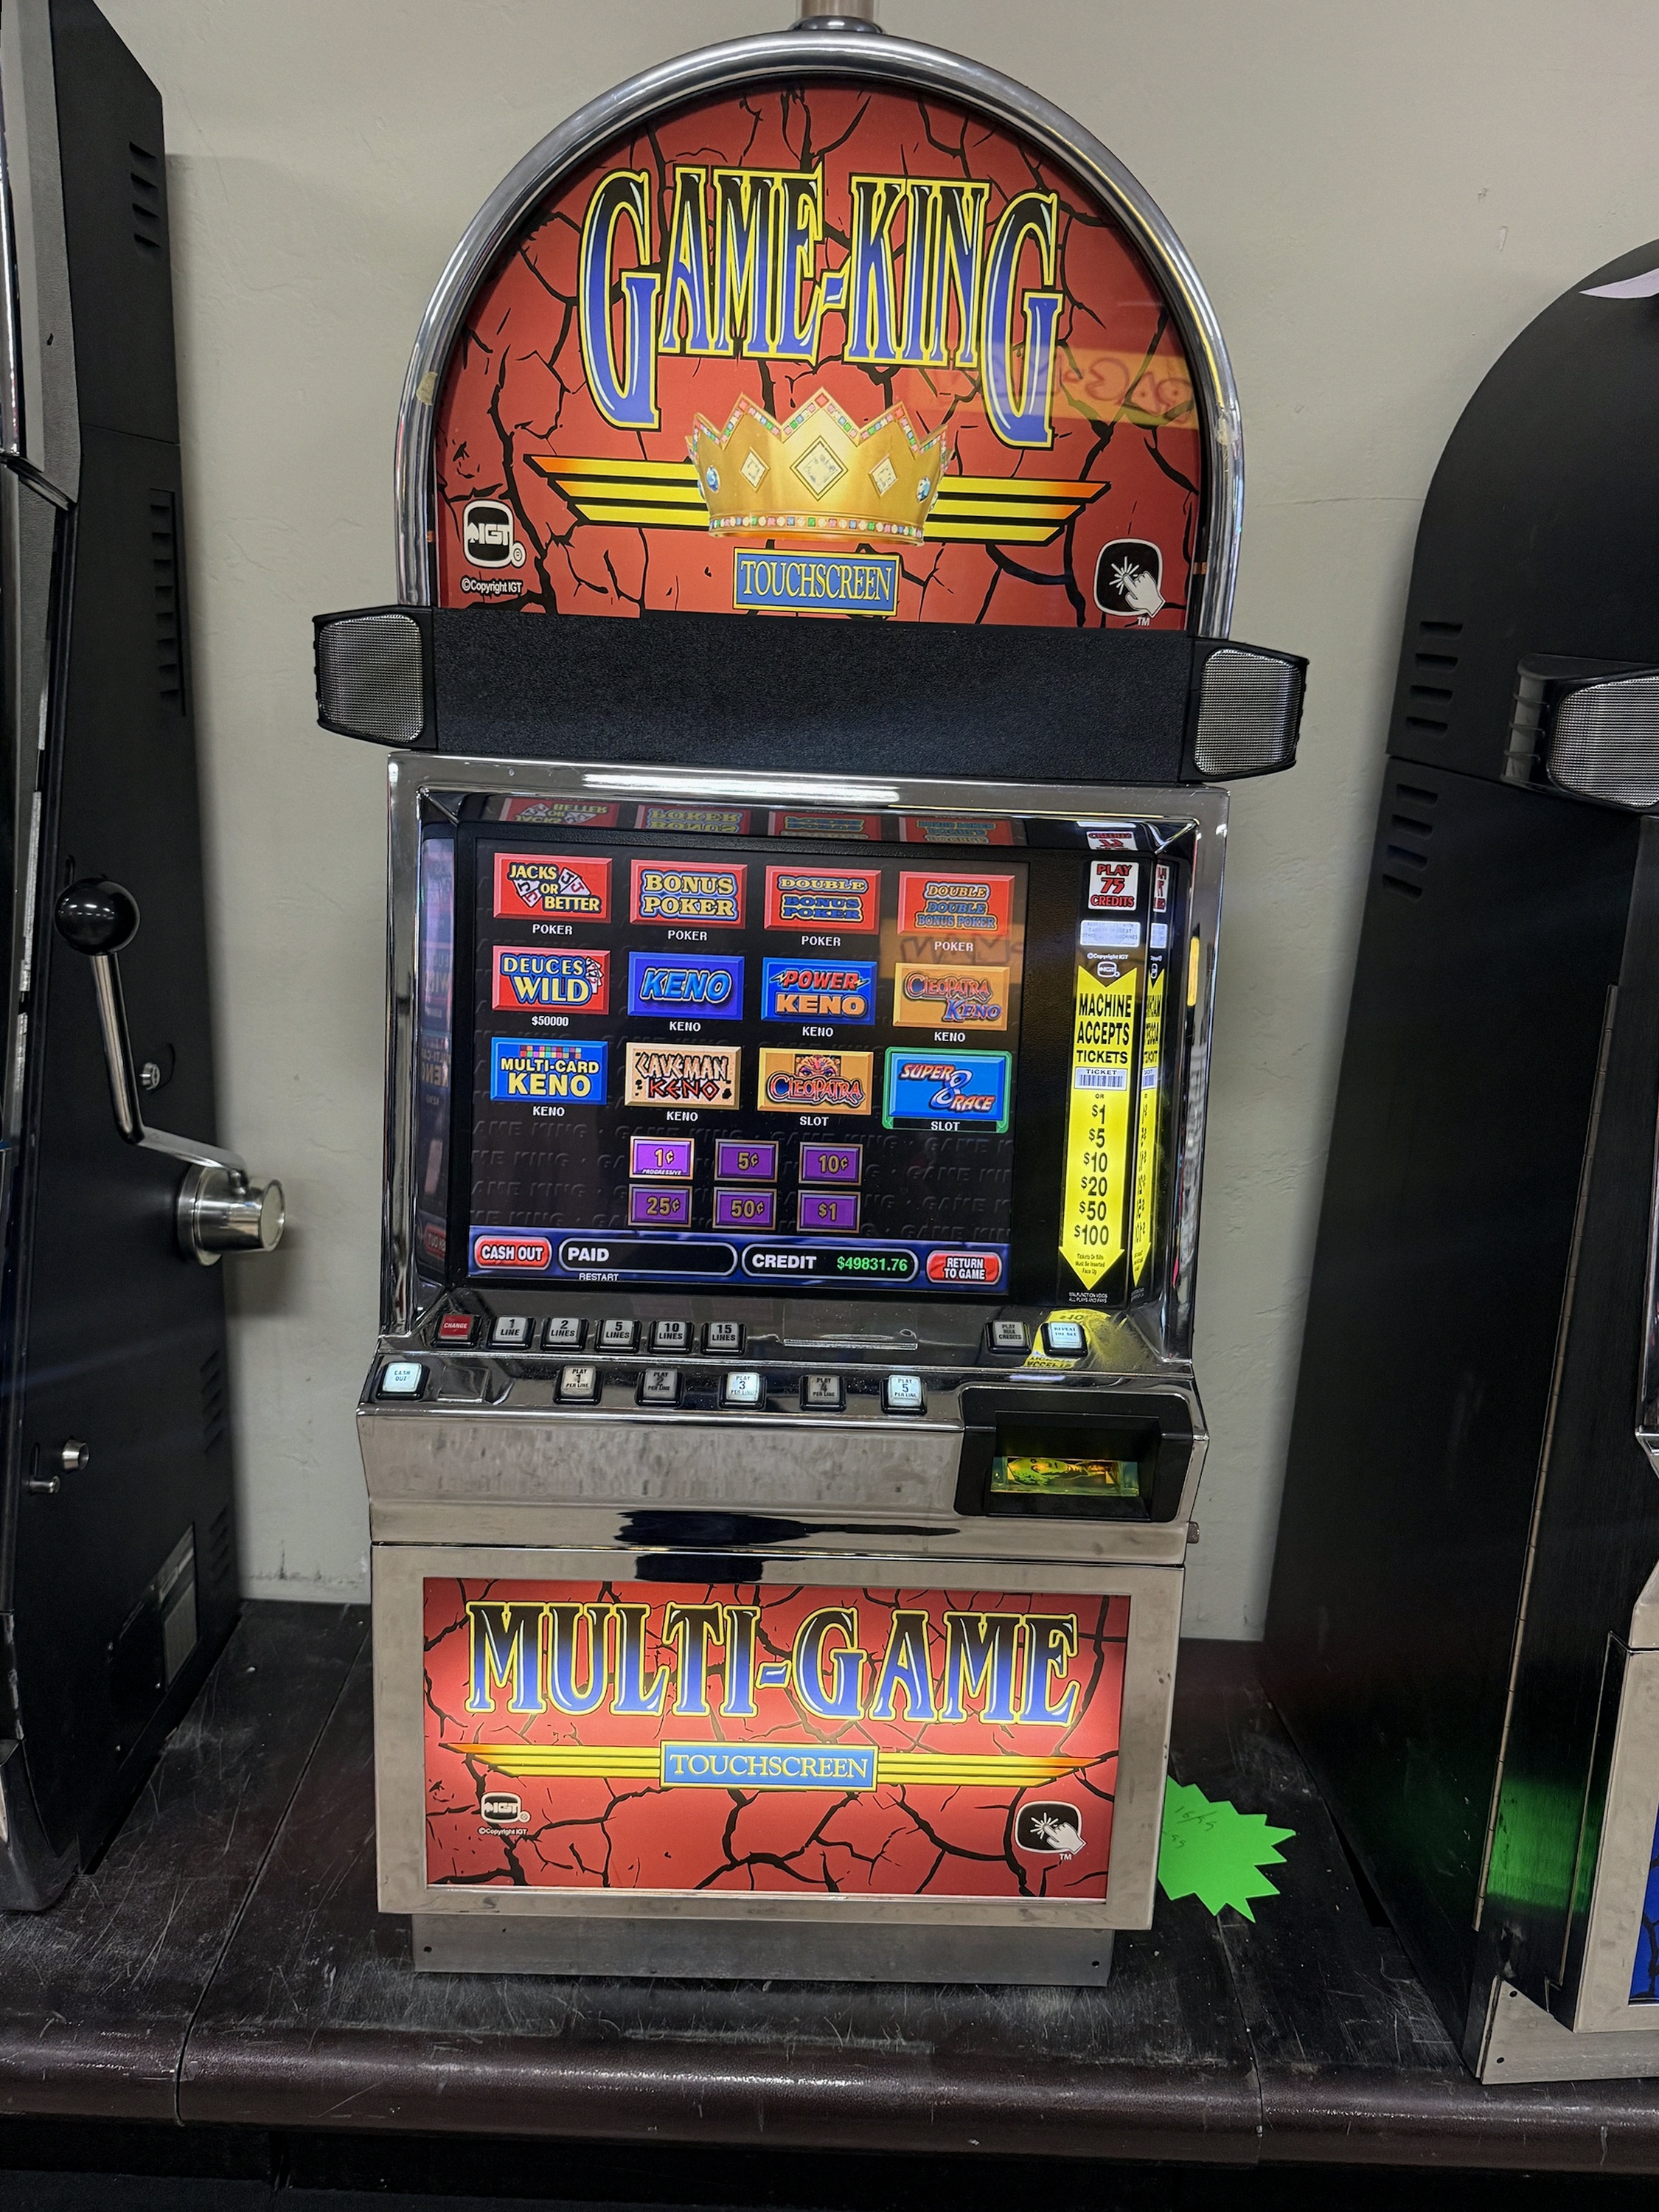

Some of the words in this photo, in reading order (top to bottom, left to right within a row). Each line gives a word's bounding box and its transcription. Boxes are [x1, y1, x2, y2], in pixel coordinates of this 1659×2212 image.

[580, 164, 1062, 448] GAME-KING
[479, 522, 509, 546] IGT
[508, 582, 522, 593] IGT
[742, 558, 893, 603] TOUCHSCREEN
[1137, 617, 1150, 626] TM
[509, 864, 557, 880] JACKS
[1096, 863, 1132, 876] PLAY
[540, 883, 558, 895] OR
[644, 873, 734, 895] BONUS
[779, 877, 866, 891] DOUBLE
[1101, 877, 1125, 894] 75
[927, 886, 987, 898] DOUBLE
[544, 897, 600, 912] BETTER
[644, 896, 734, 917] POKER
[783, 897, 860, 908] BONUS
[1091, 894, 1135, 907] CREDITS
[783, 908, 862, 919] POKER
[927, 902, 987, 914] DOUBLE
[918, 915, 953, 926] BONUS
[959, 917, 995, 929] POKER
[532, 924, 573, 935] POKER
[668, 930, 708, 941] POKER
[801, 936, 841, 947] POKER
[934, 941, 973, 952] POKER
[504, 956, 583, 975] DEUCES
[642, 970, 731, 1001] KENO
[783, 970, 858, 990] POWER
[906, 973, 991, 1001] CLEOPATRA
[515, 975, 590, 1004] WILD
[776, 993, 866, 1015] KENO
[945, 1000, 1001, 1022] KENO
[1079, 993, 1131, 1018] MACHINE
[532, 1015, 568, 1026] $50000
[669, 1021, 700, 1032] KENO
[802, 1026, 834, 1037] KENO
[934, 1032, 966, 1043] KENO
[1077, 1020, 1130, 1046] ACCEPTS
[1076, 1050, 1128, 1063] TICKETS
[501, 1057, 599, 1074] MULTI-CARD
[636, 1052, 728, 1082] CAVEMAN
[900, 1063, 954, 1080] SUPER
[508, 1073, 591, 1097] KENO
[648, 1080, 720, 1101] KENO
[768, 1074, 865, 1106] CLEOPATRA
[950, 1095, 995, 1113] RACE
[532, 1106, 565, 1117] KENO
[667, 1111, 698, 1121] KENO
[1091, 1105, 1105, 1124] $1
[799, 1116, 829, 1127] SLOT
[931, 1121, 960, 1131] SLOT
[1088, 1128, 1105, 1148] $5
[654, 1148, 674, 1167] 1¢
[738, 1152, 759, 1170] 5¢
[819, 1155, 849, 1174] 10¢
[1083, 1152, 1107, 1172] $10
[641, 1168, 682, 1176] PROGRESSIVE
[1080, 1176, 1107, 1197] $20
[647, 1197, 680, 1215] 25¢
[731, 1199, 765, 1218] 50¢
[818, 1203, 837, 1221] $1
[1079, 1200, 1107, 1221] $50
[1074, 1225, 1109, 1245] $100
[481, 1245, 515, 1261] CASH
[517, 1245, 544, 1261] OUT
[568, 1248, 609, 1262] PAID
[752, 1254, 816, 1269] CREDIT
[837, 1256, 908, 1272] $49831.76
[947, 1256, 984, 1269] RETURN
[579, 1273, 619, 1281] RESTART
[944, 1268, 957, 1279] TO
[959, 1268, 985, 1280] GAME
[509, 1318, 515, 1328] 1
[560, 1320, 569, 1329] 2
[615, 1321, 623, 1331] 5
[665, 1323, 679, 1332] 10
[717, 1324, 732, 1334] 15
[550, 1329, 575, 1337] LINES
[605, 1330, 630, 1339] LINES
[658, 1332, 683, 1340] LINES
[712, 1333, 736, 1341] LINES
[739, 1381, 745, 1390] 3
[902, 1384, 908, 1392] 5
[465, 1601, 1080, 1727] MULTI-GAME
[670, 1752, 869, 1780] TOUCHSCREEN
[493, 1802, 518, 1814] IGT
